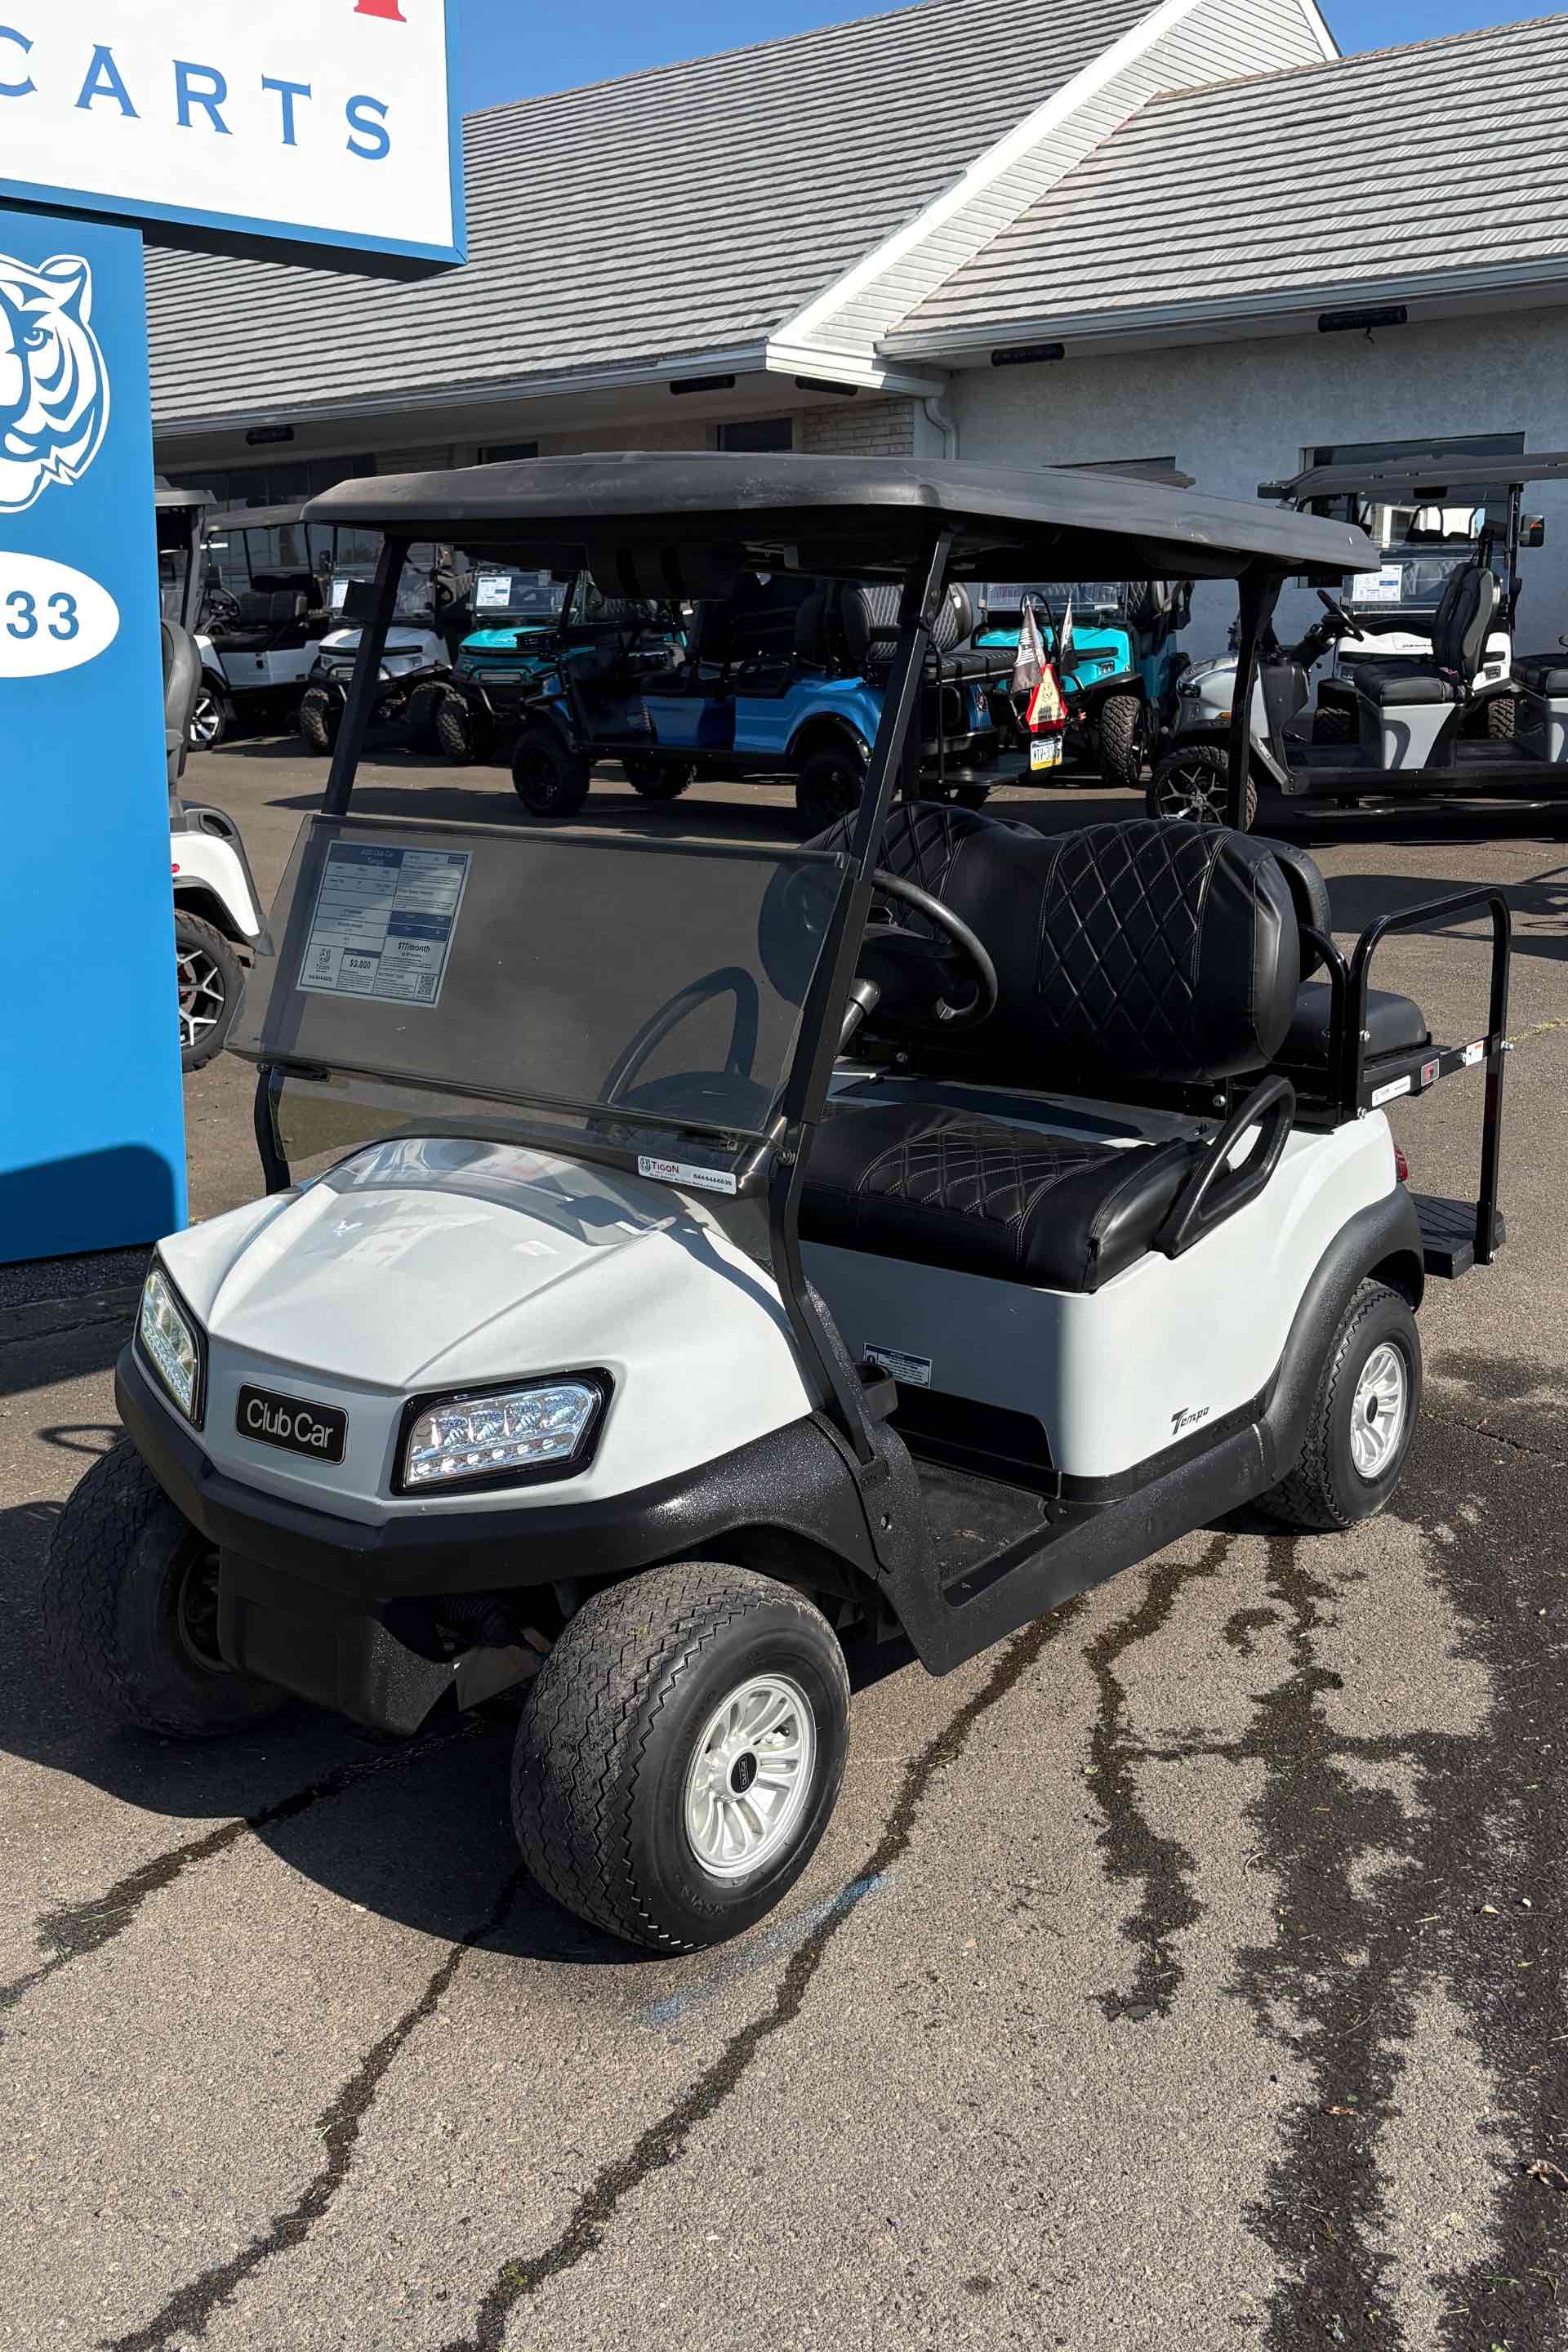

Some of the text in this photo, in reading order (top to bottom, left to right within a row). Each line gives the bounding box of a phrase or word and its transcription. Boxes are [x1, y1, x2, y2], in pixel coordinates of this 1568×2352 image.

[6, 590, 79, 640] 33
[652, 1161, 679, 1174] TIGON
[247, 1399, 334, 1448] Club Car
[1170, 1406, 1209, 1435] Tempo
